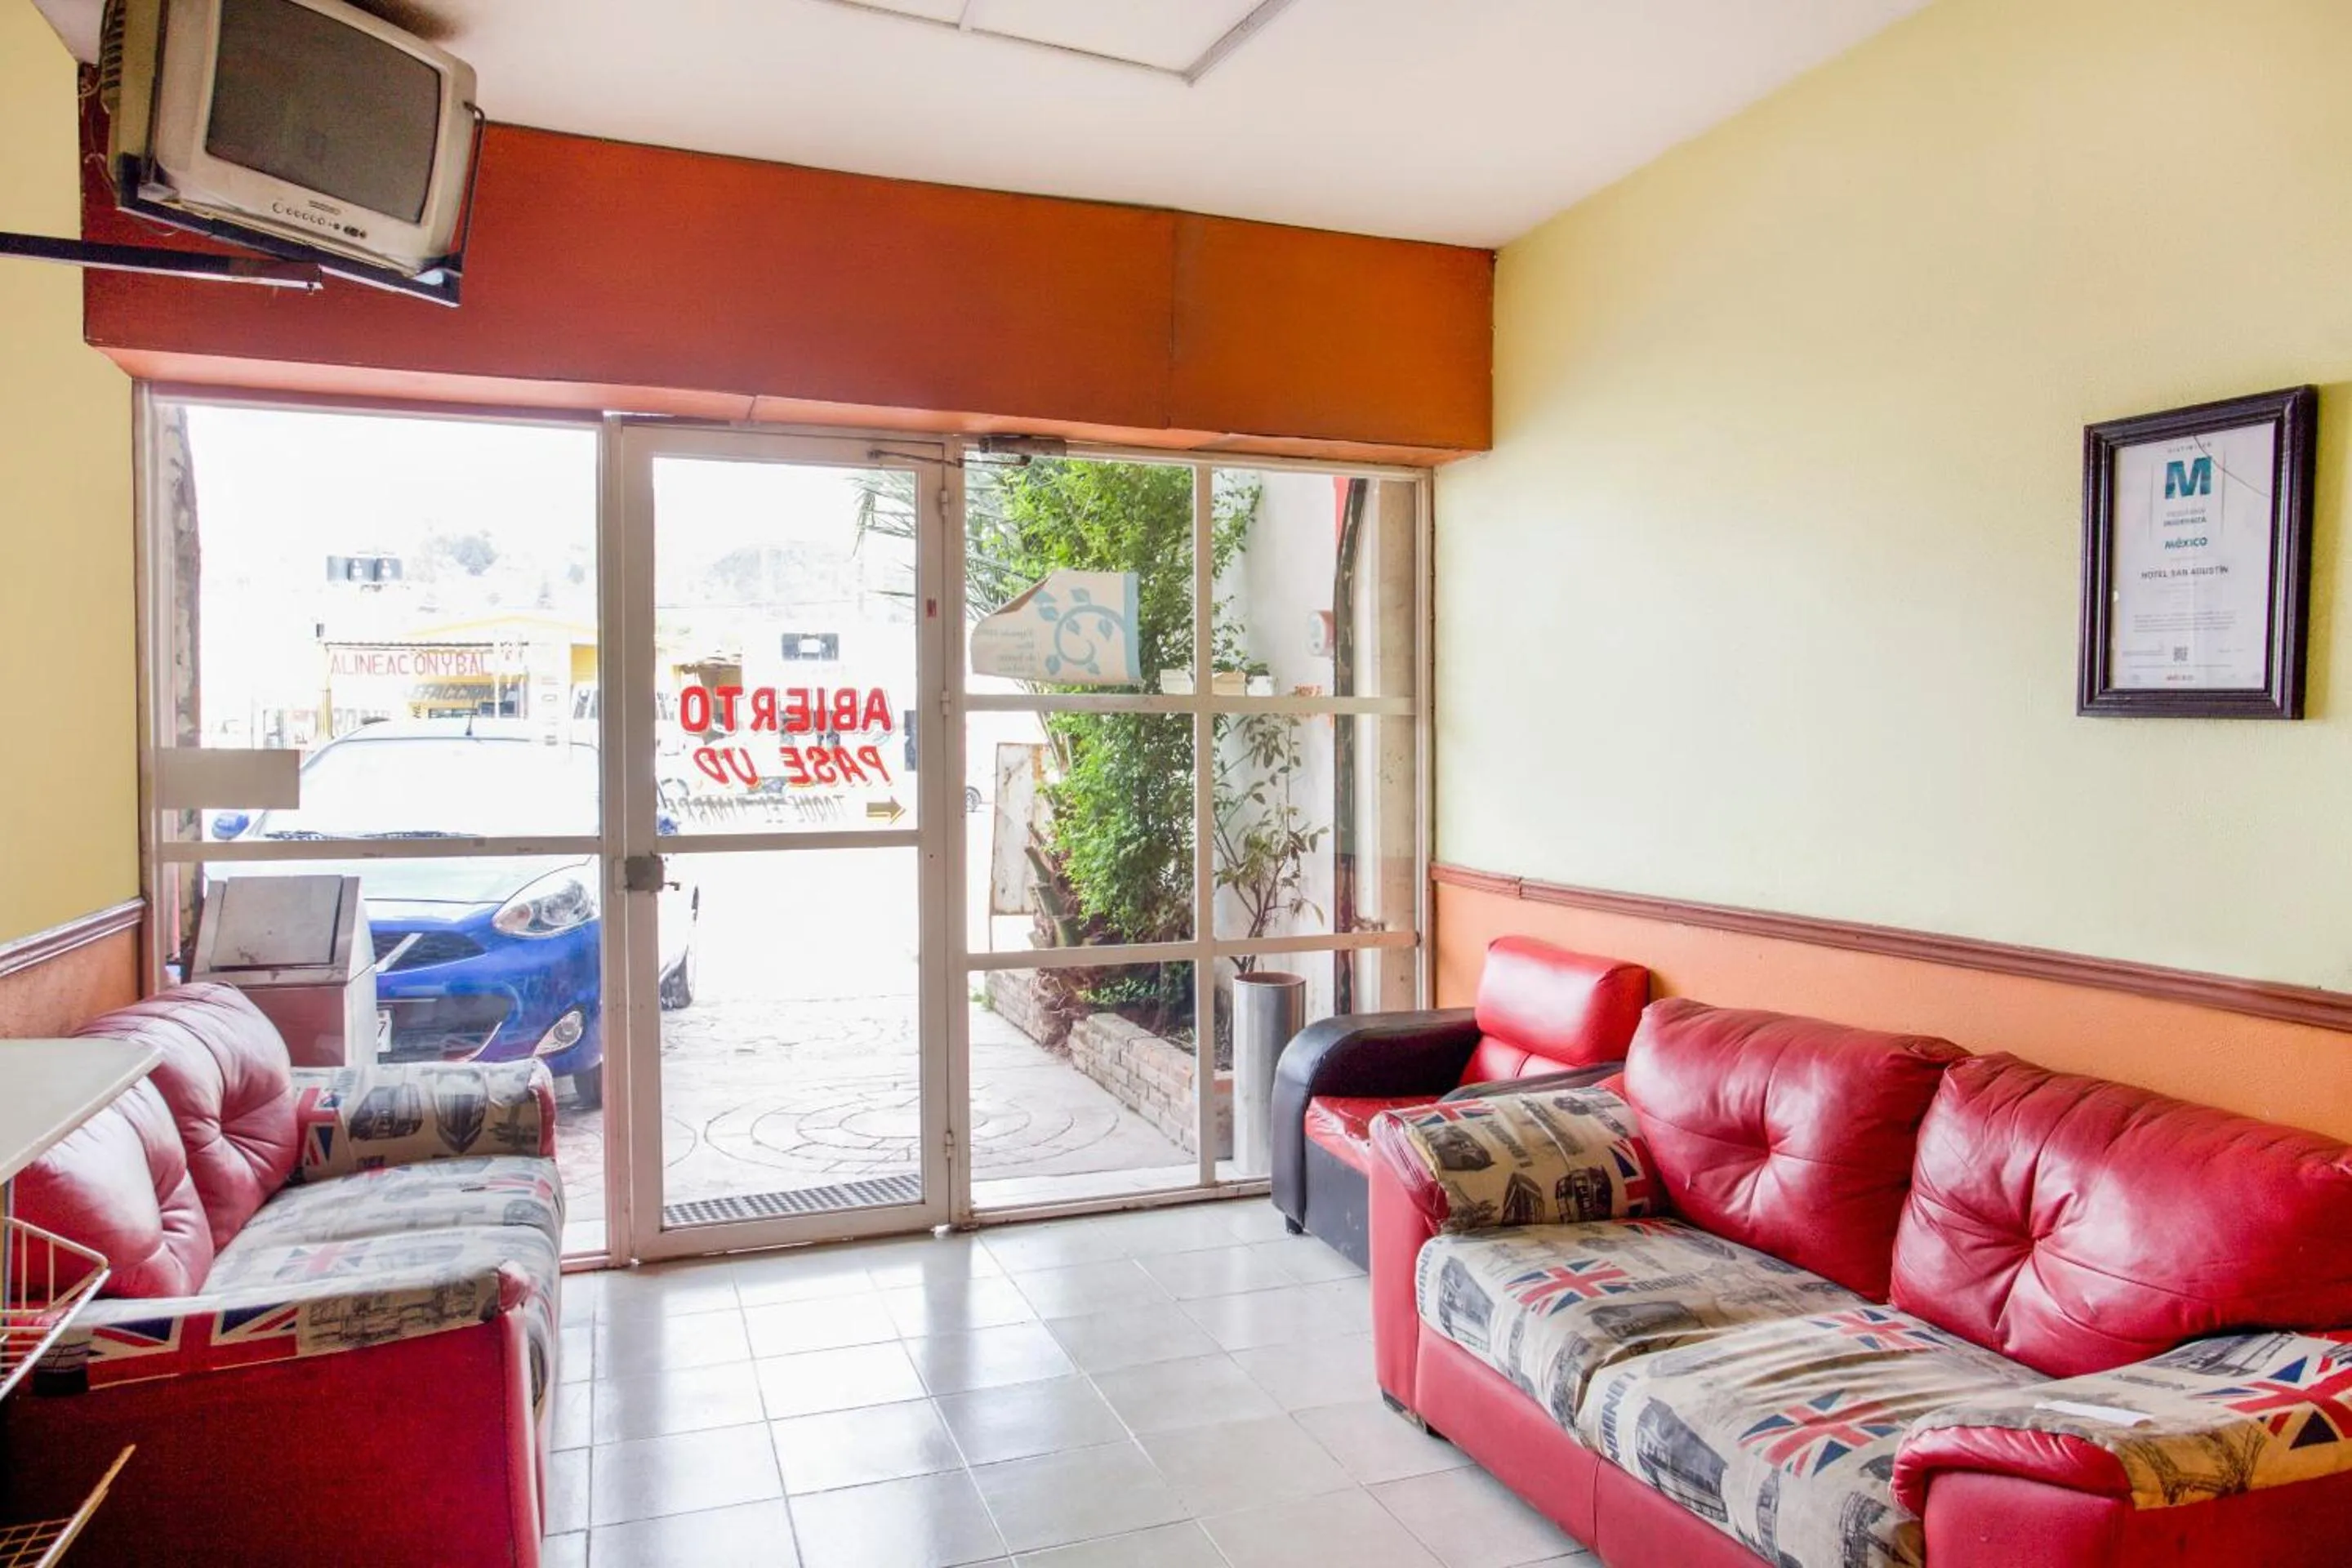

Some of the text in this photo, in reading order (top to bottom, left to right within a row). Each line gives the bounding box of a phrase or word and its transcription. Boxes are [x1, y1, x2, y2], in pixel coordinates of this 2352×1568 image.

[2165, 456, 2212, 499] M
[2141, 569, 2168, 579] HOTEL
[2172, 568, 2189, 577] SAN
